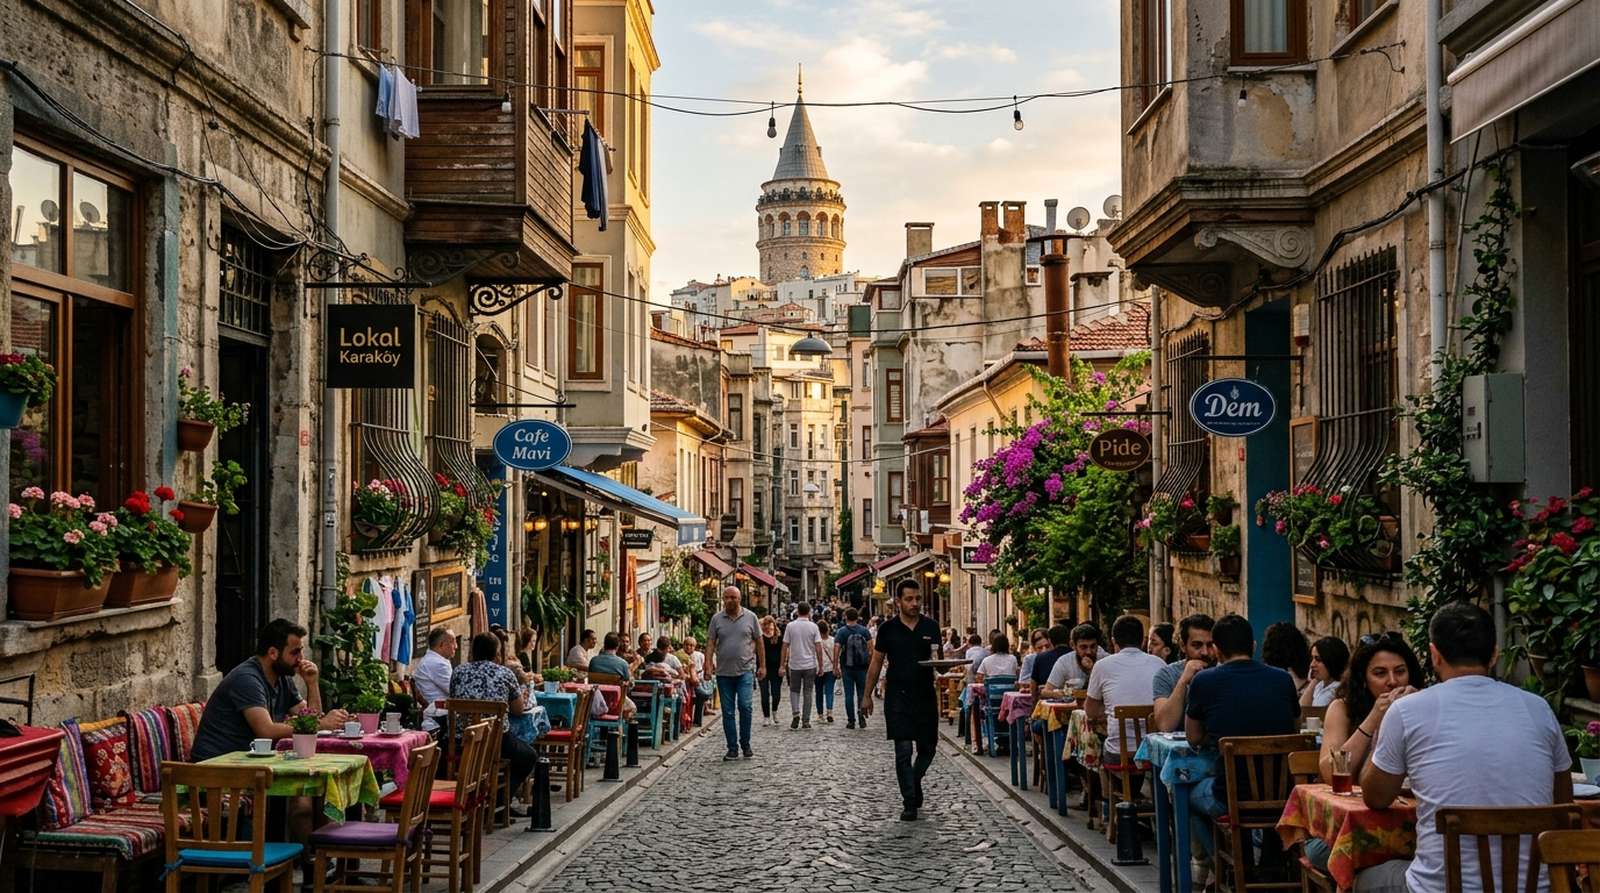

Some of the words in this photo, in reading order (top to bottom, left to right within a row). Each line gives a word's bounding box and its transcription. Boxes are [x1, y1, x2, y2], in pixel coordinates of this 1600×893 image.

[340, 326, 402, 347] Lokal
[340, 350, 401, 367] Karaköy
[1204, 393, 1263, 417] Dem
[514, 428, 549, 446] Cafe
[511, 446, 551, 460] Mavi
[1099, 438, 1142, 457] Pide
